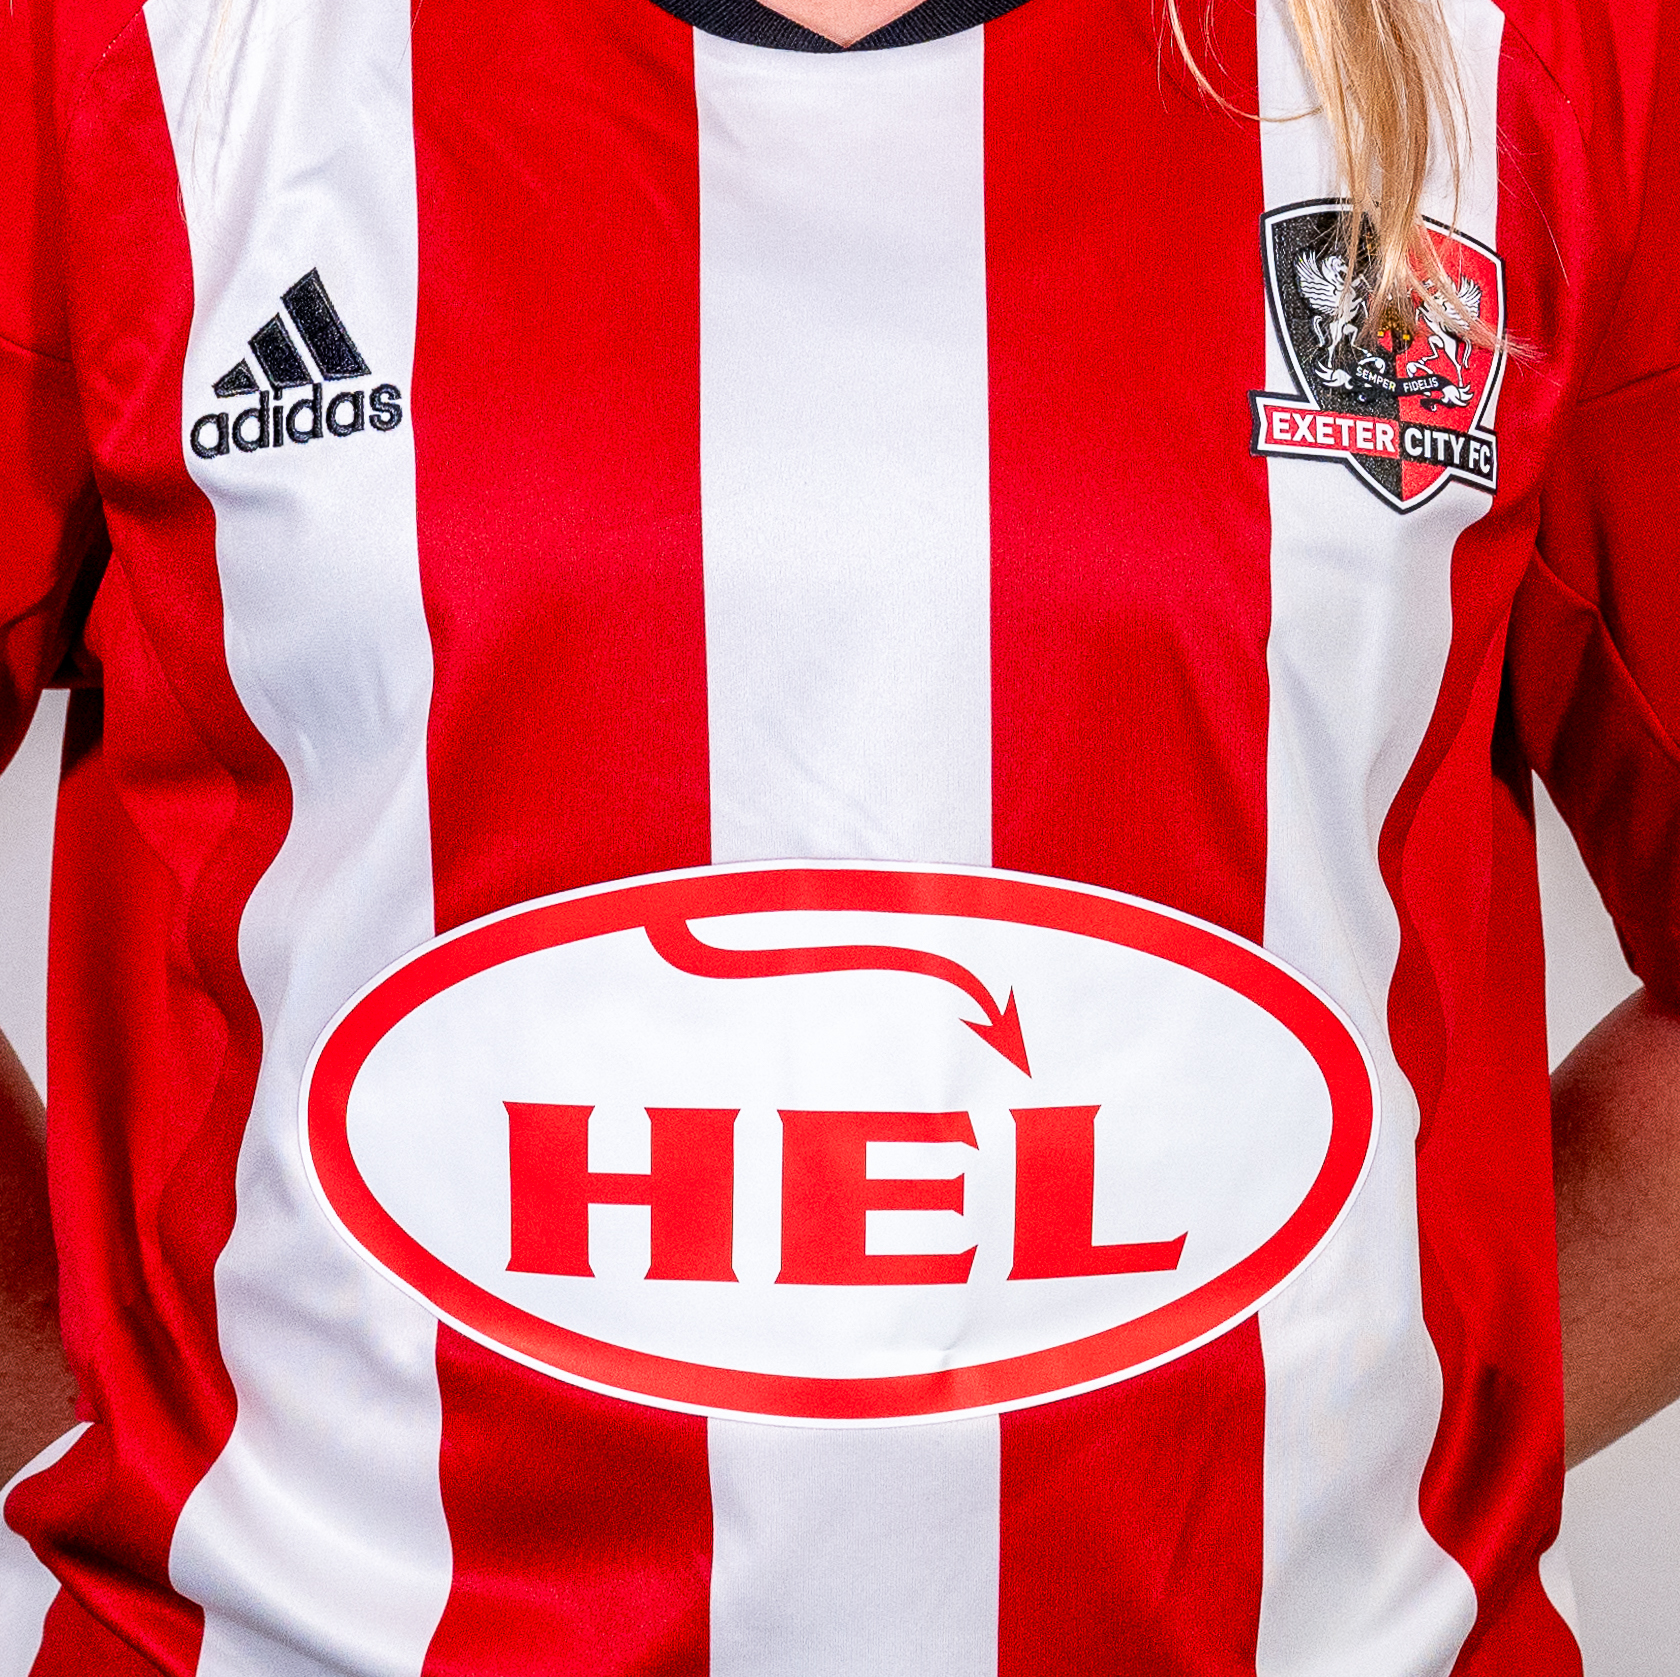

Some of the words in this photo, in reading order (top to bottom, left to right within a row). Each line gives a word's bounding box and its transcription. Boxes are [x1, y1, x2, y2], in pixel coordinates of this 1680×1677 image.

[1356, 366, 1397, 392] SEMPER
[1403, 376, 1439, 392] FIDELIS
[190, 382, 403, 459] adidas
[1272, 411, 1395, 452] EXETER
[1404, 426, 1466, 465] CITY
[1469, 444, 1491, 474] FC
[503, 1101, 1188, 1285] HEL
